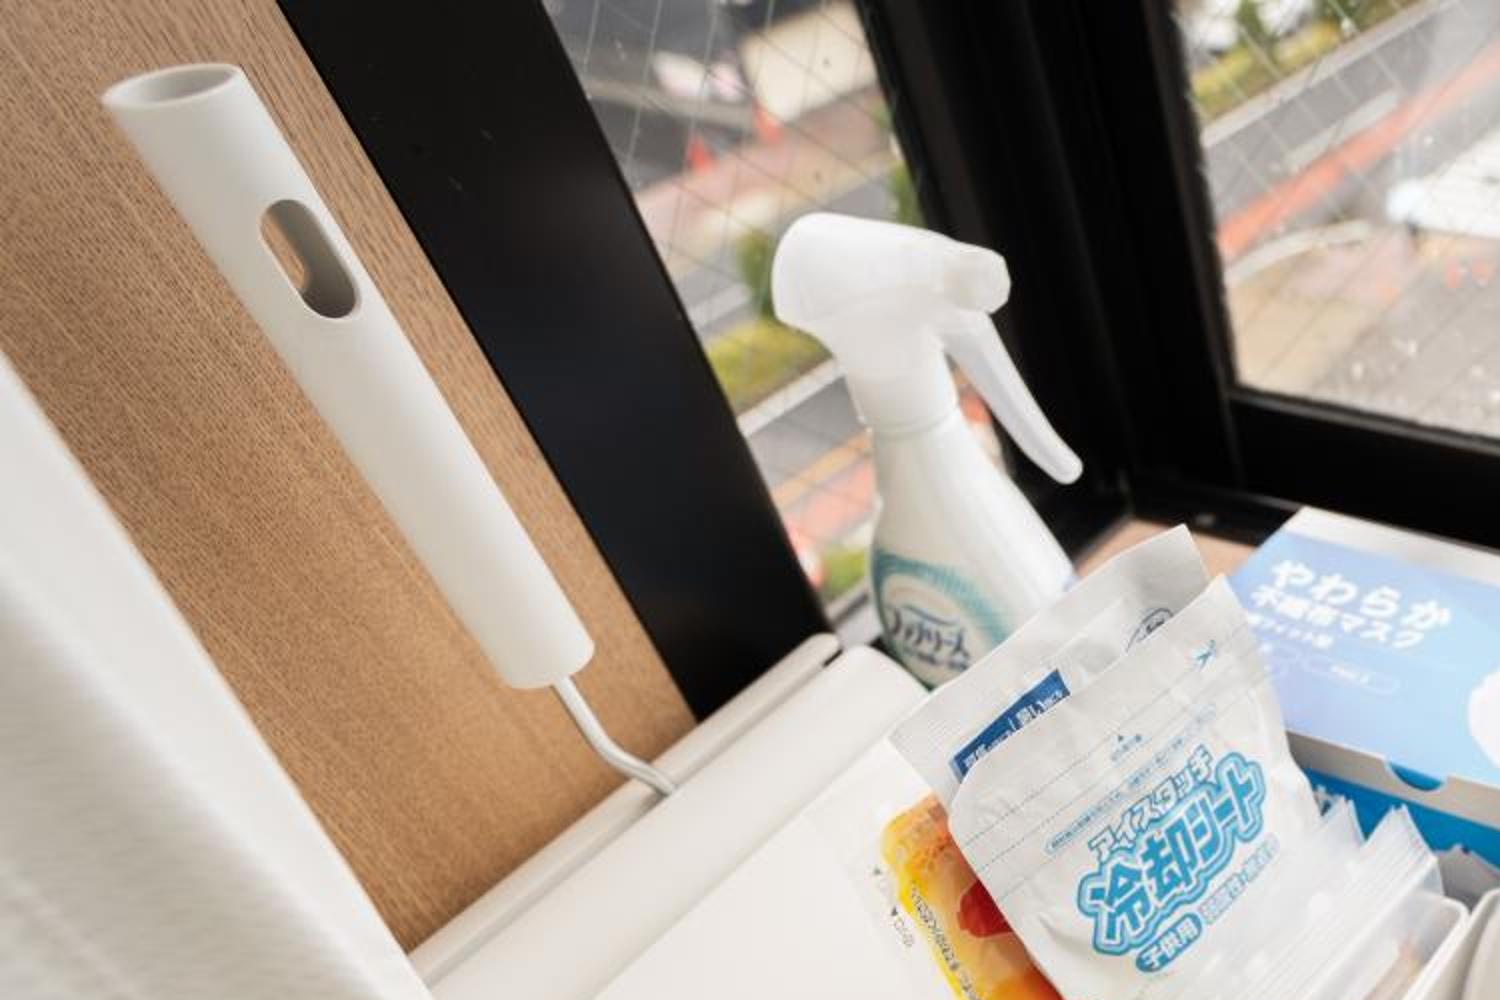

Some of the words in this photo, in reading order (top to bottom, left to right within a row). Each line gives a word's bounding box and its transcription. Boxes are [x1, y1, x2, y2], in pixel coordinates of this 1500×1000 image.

[1272, 560, 1451, 630] やわらか
[1088, 744, 1213, 864] アイスタッチ
[1086, 764, 1258, 945] 冷却シート
[1139, 916, 1199, 968] 子供用
